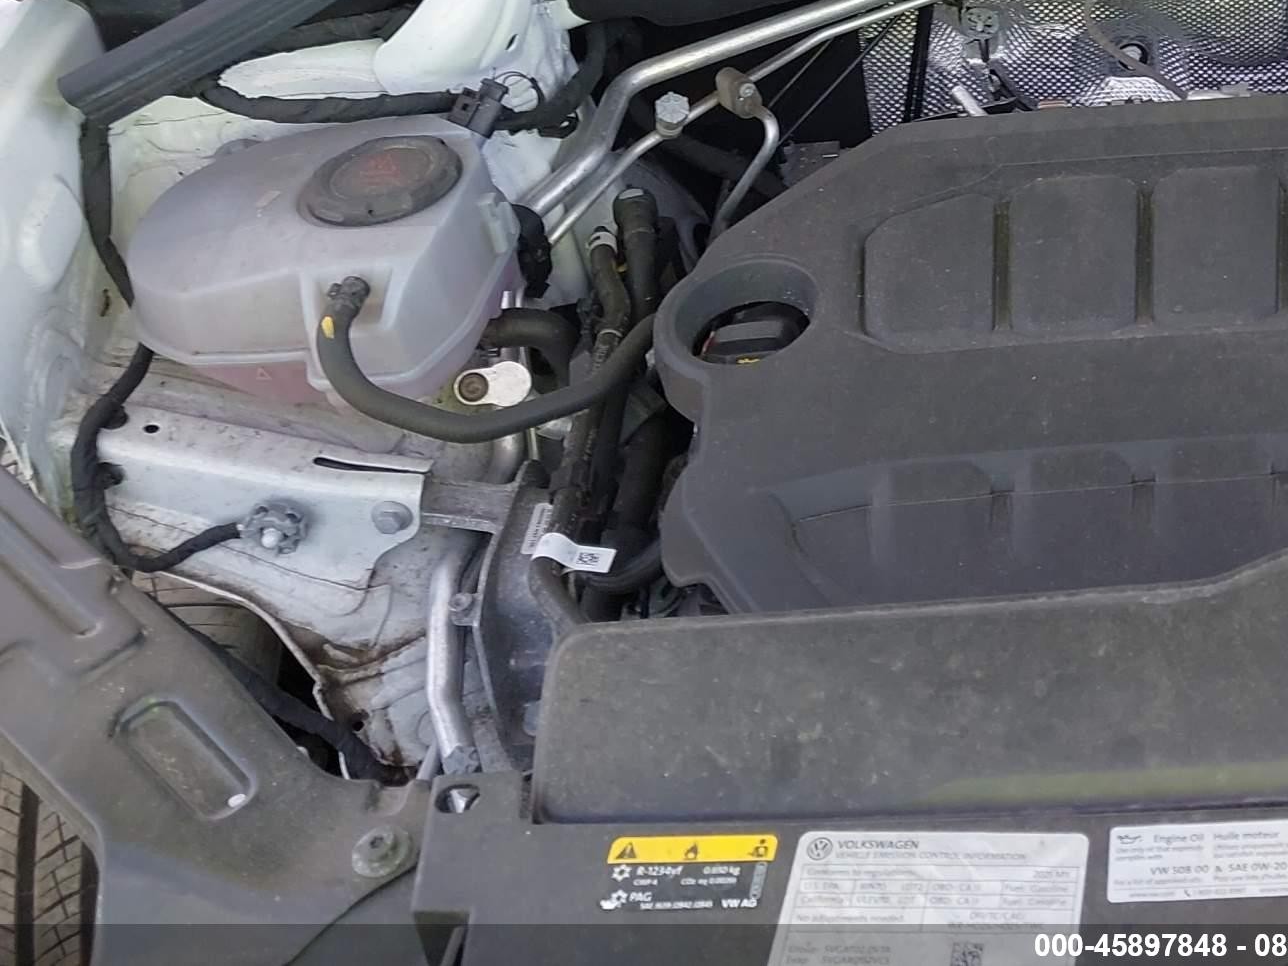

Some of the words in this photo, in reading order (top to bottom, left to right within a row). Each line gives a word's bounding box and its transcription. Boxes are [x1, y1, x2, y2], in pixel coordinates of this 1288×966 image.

[1153, 834, 1187, 845] Engine
[1190, 833, 1204, 842] Oil
[1241, 830, 1280, 840] moteur
[838, 840, 919, 850] VOLKSWAGEN
[636, 865, 683, 878] R-1234yf
[1150, 866, 1169, 875] VW
[1228, 863, 1248, 873] SAE
[1251, 862, 1288, 871] 0W-20
[629, 891, 652, 902] PAG
[721, 898, 740, 908] VW
[740, 897, 758, 908] AG
